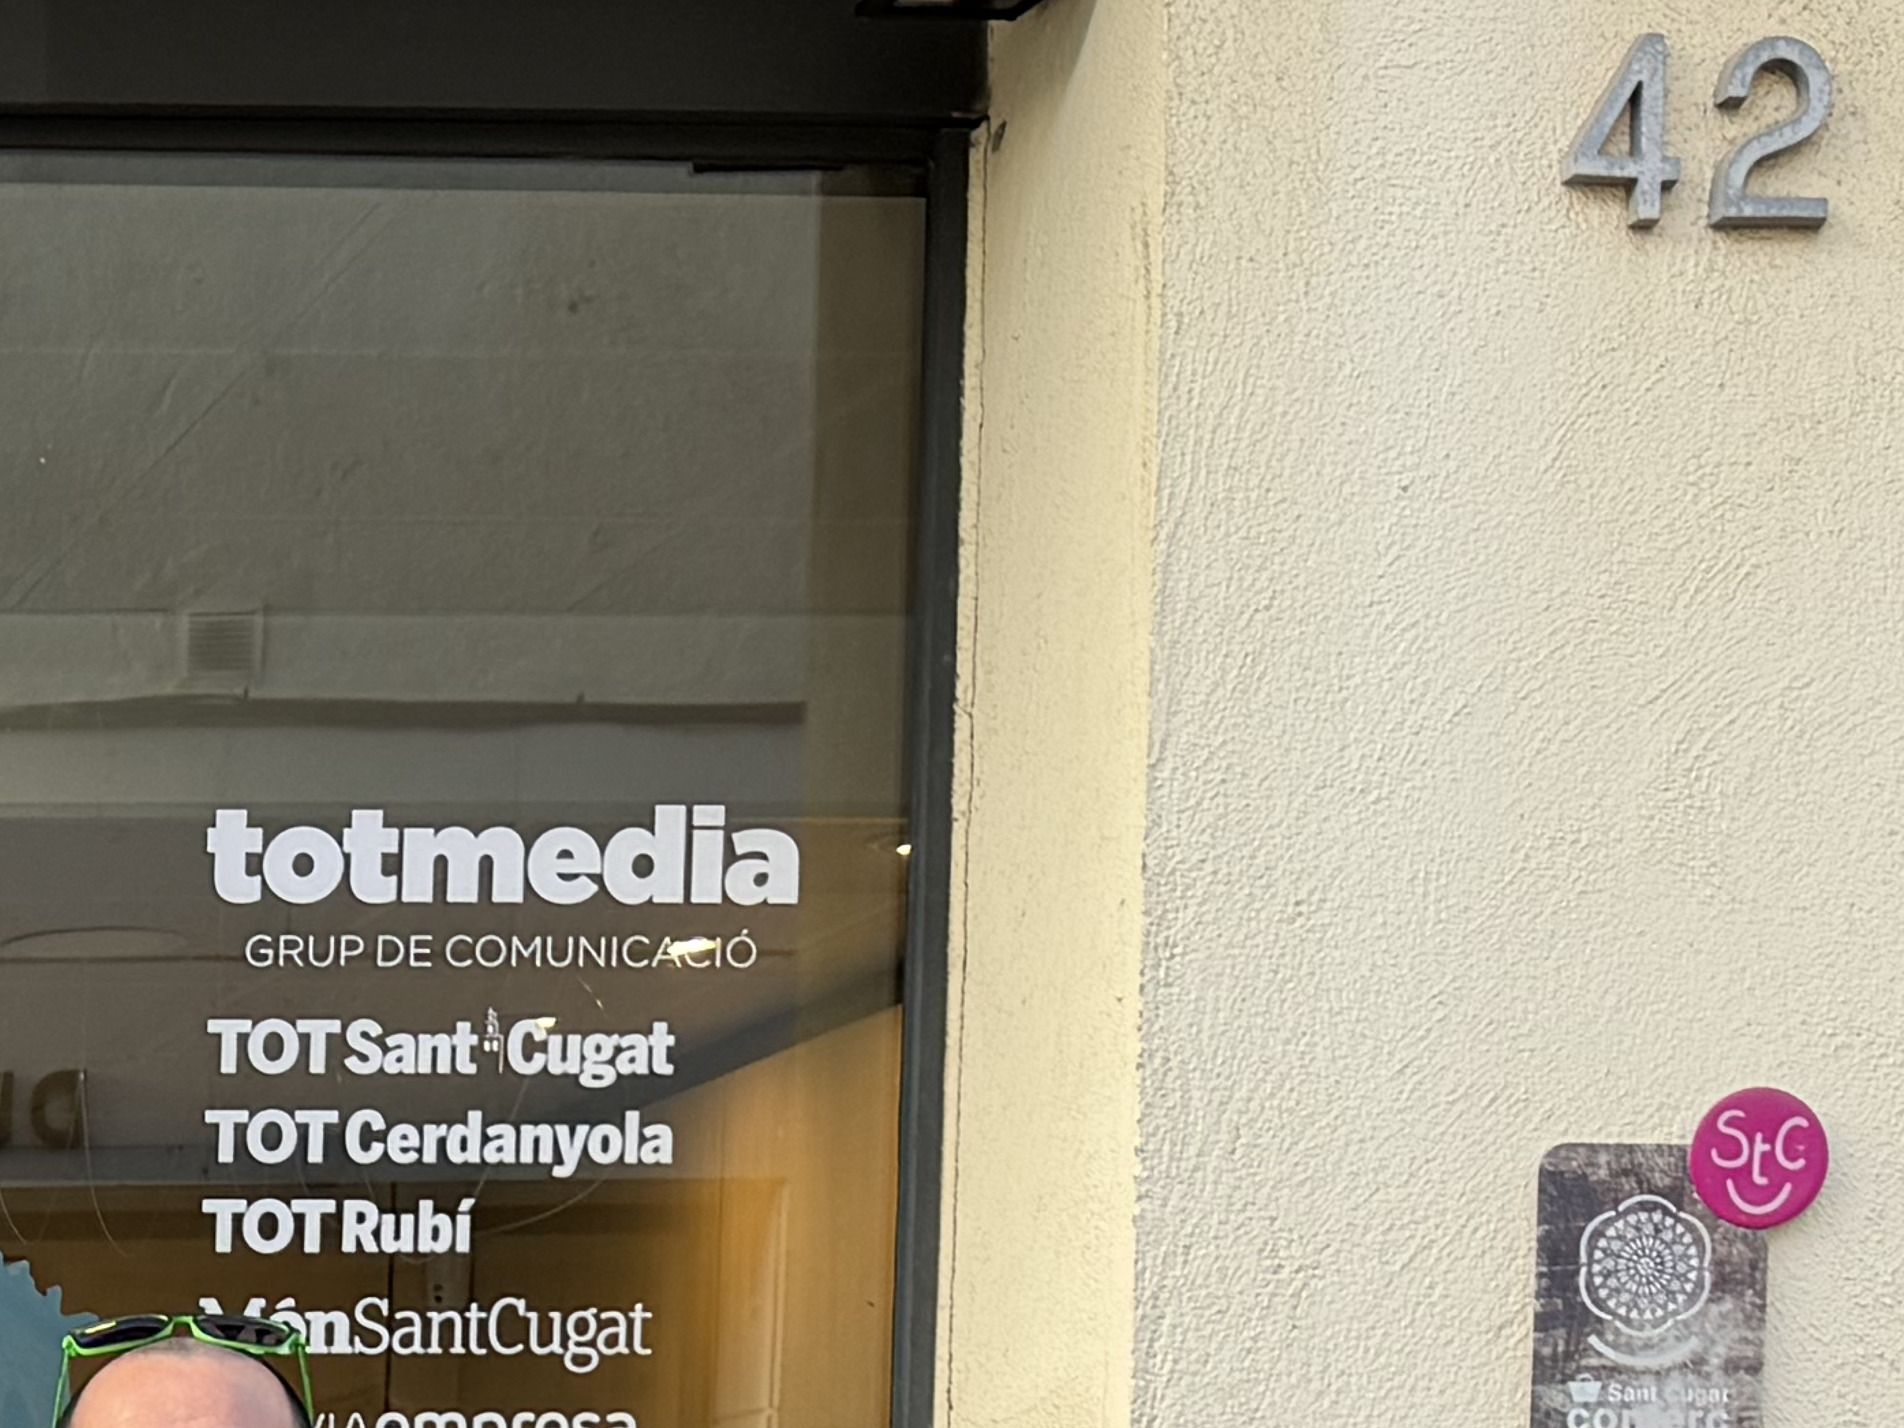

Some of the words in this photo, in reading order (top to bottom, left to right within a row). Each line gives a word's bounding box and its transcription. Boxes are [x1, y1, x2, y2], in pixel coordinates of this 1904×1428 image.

[1562, 32, 1832, 229] 42
[206, 804, 800, 905] totmedia
[244, 934, 364, 969] GRUP
[376, 935, 433, 968] DE
[444, 928, 758, 969] COMUNICACIÓ
[206, 1019, 342, 1075] TOT
[345, 1021, 478, 1075] Sant
[507, 1021, 676, 1087] Cugat
[204, 1110, 339, 1164] TOT
[345, 1111, 674, 1177] Cerdanyola
[1711, 1110, 1809, 1184] StC
[202, 1199, 337, 1254] TOT
[343, 1198, 472, 1254] Rubí
